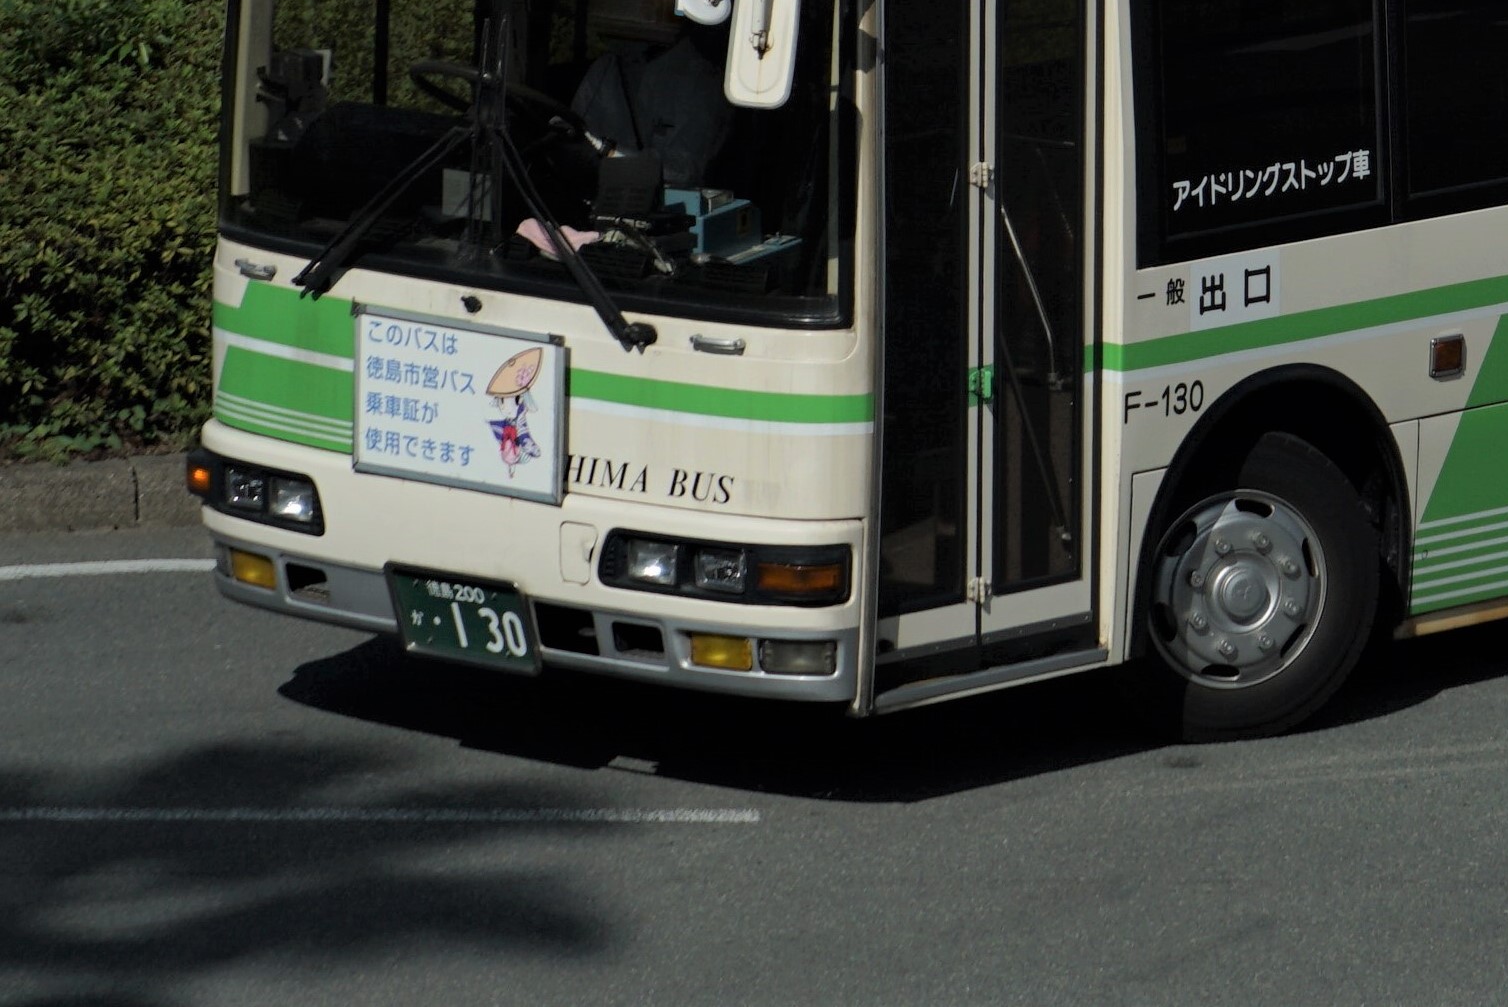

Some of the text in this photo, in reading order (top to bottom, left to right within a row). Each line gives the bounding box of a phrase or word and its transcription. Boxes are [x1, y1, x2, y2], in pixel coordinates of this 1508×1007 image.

[1172, 149, 1370, 211] アイドリングストップ車
[1137, 265, 1271, 315] 一般 出口
[368, 321, 459, 354] このバスは
[366, 355, 476, 395] 徳島市営バス
[366, 391, 438, 423] 乗車証が
[1124, 379, 1204, 424] F-130
[365, 427, 475, 466] 使用できます
[668, 468, 735, 504] BUS
